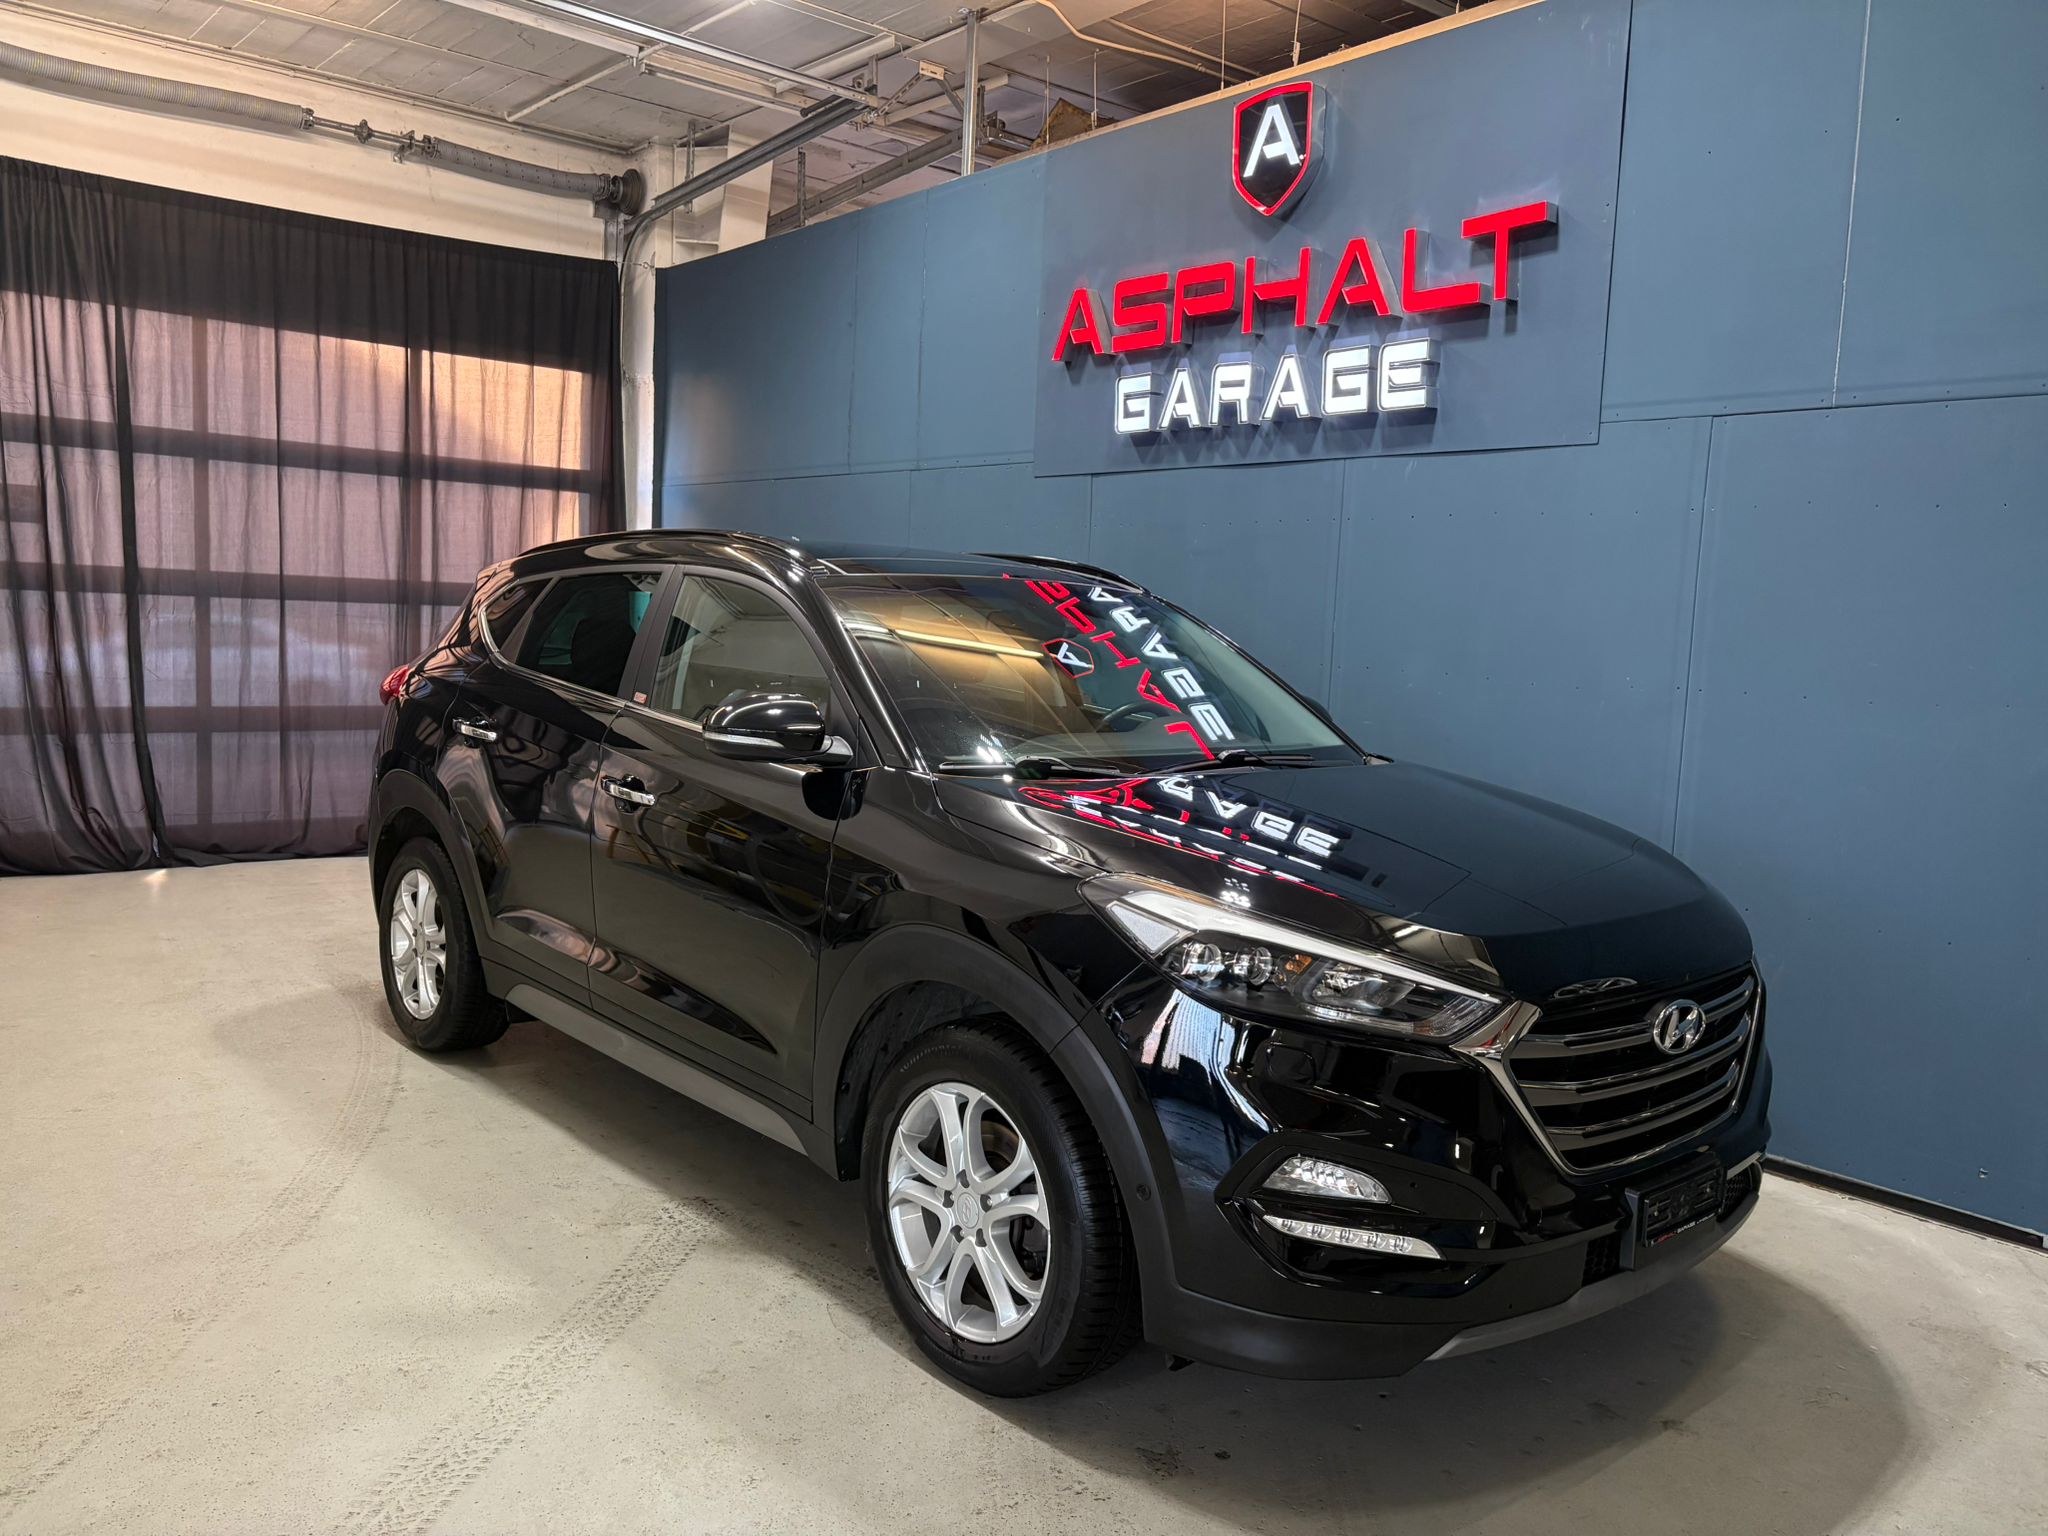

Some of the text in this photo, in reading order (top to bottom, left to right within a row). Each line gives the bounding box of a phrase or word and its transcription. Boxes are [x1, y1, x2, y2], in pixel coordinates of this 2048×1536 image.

[1243, 104, 1300, 177] A
[1052, 200, 1552, 362] ASPHALT
[1114, 336, 1432, 435] GARAGE
